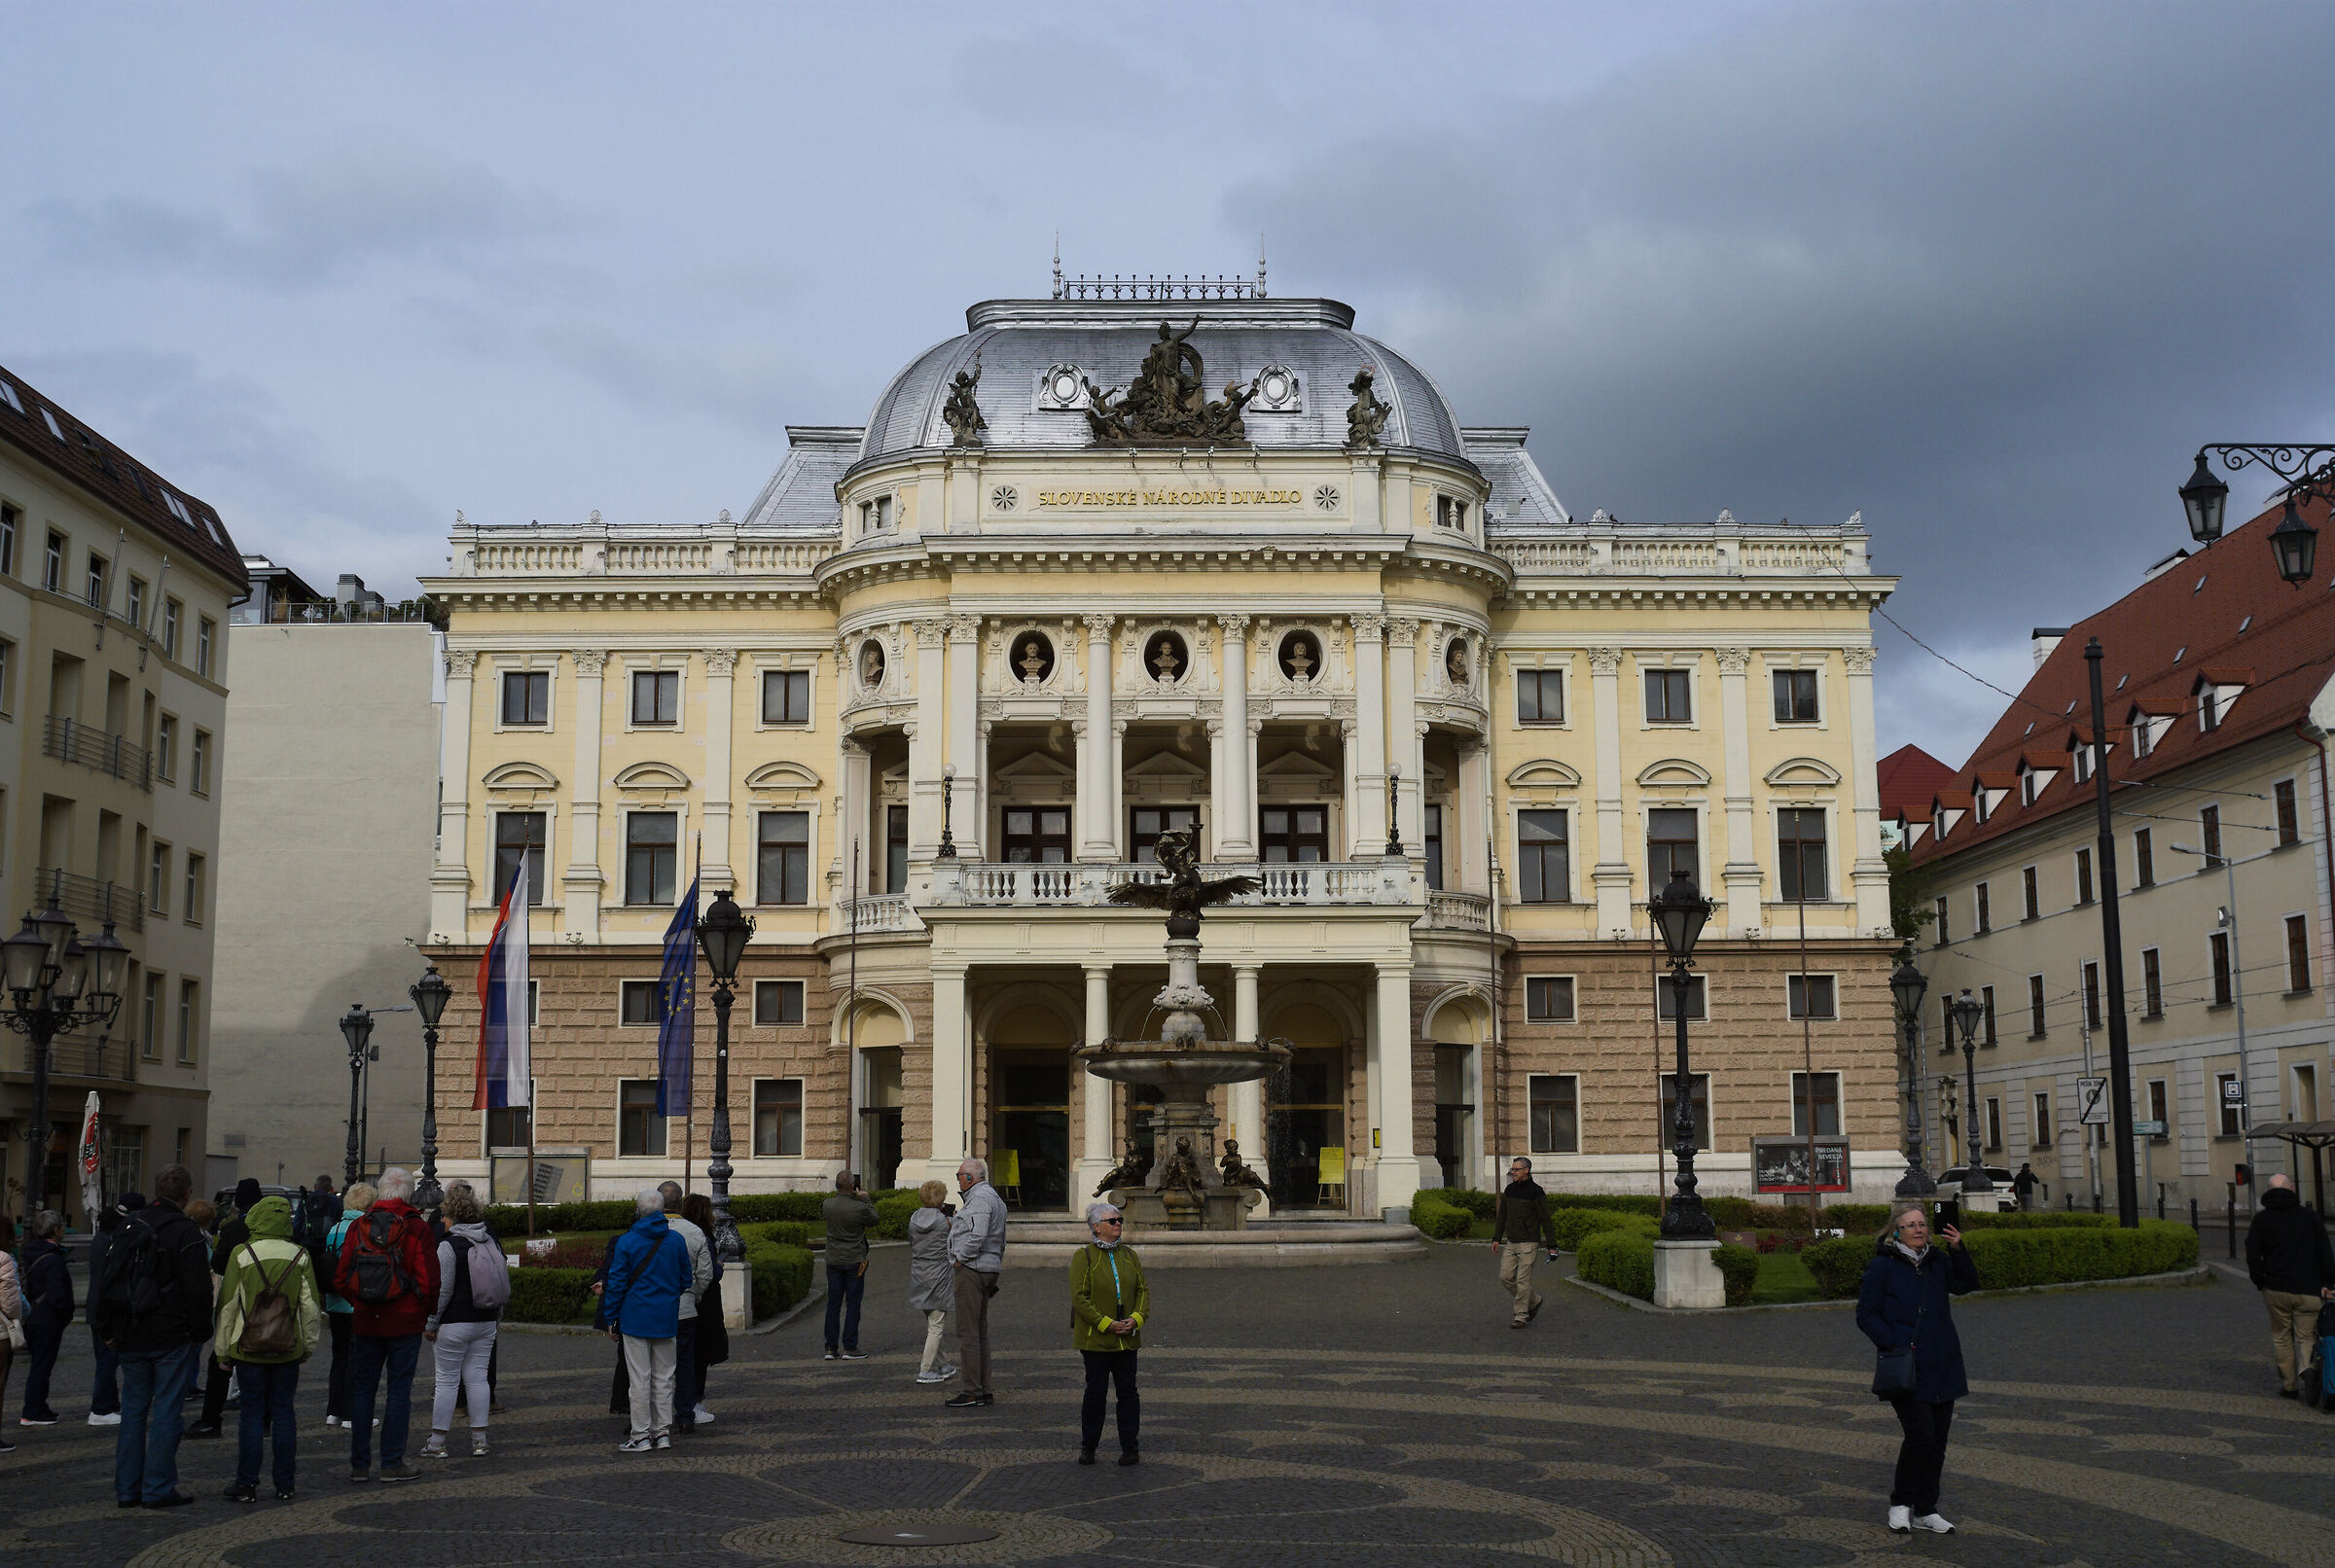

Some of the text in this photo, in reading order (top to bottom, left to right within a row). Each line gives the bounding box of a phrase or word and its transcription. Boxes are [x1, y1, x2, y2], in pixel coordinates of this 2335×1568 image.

[1038, 486, 1302, 506] SLOVENSKÉ NÁRODNÉ DIVADLO
